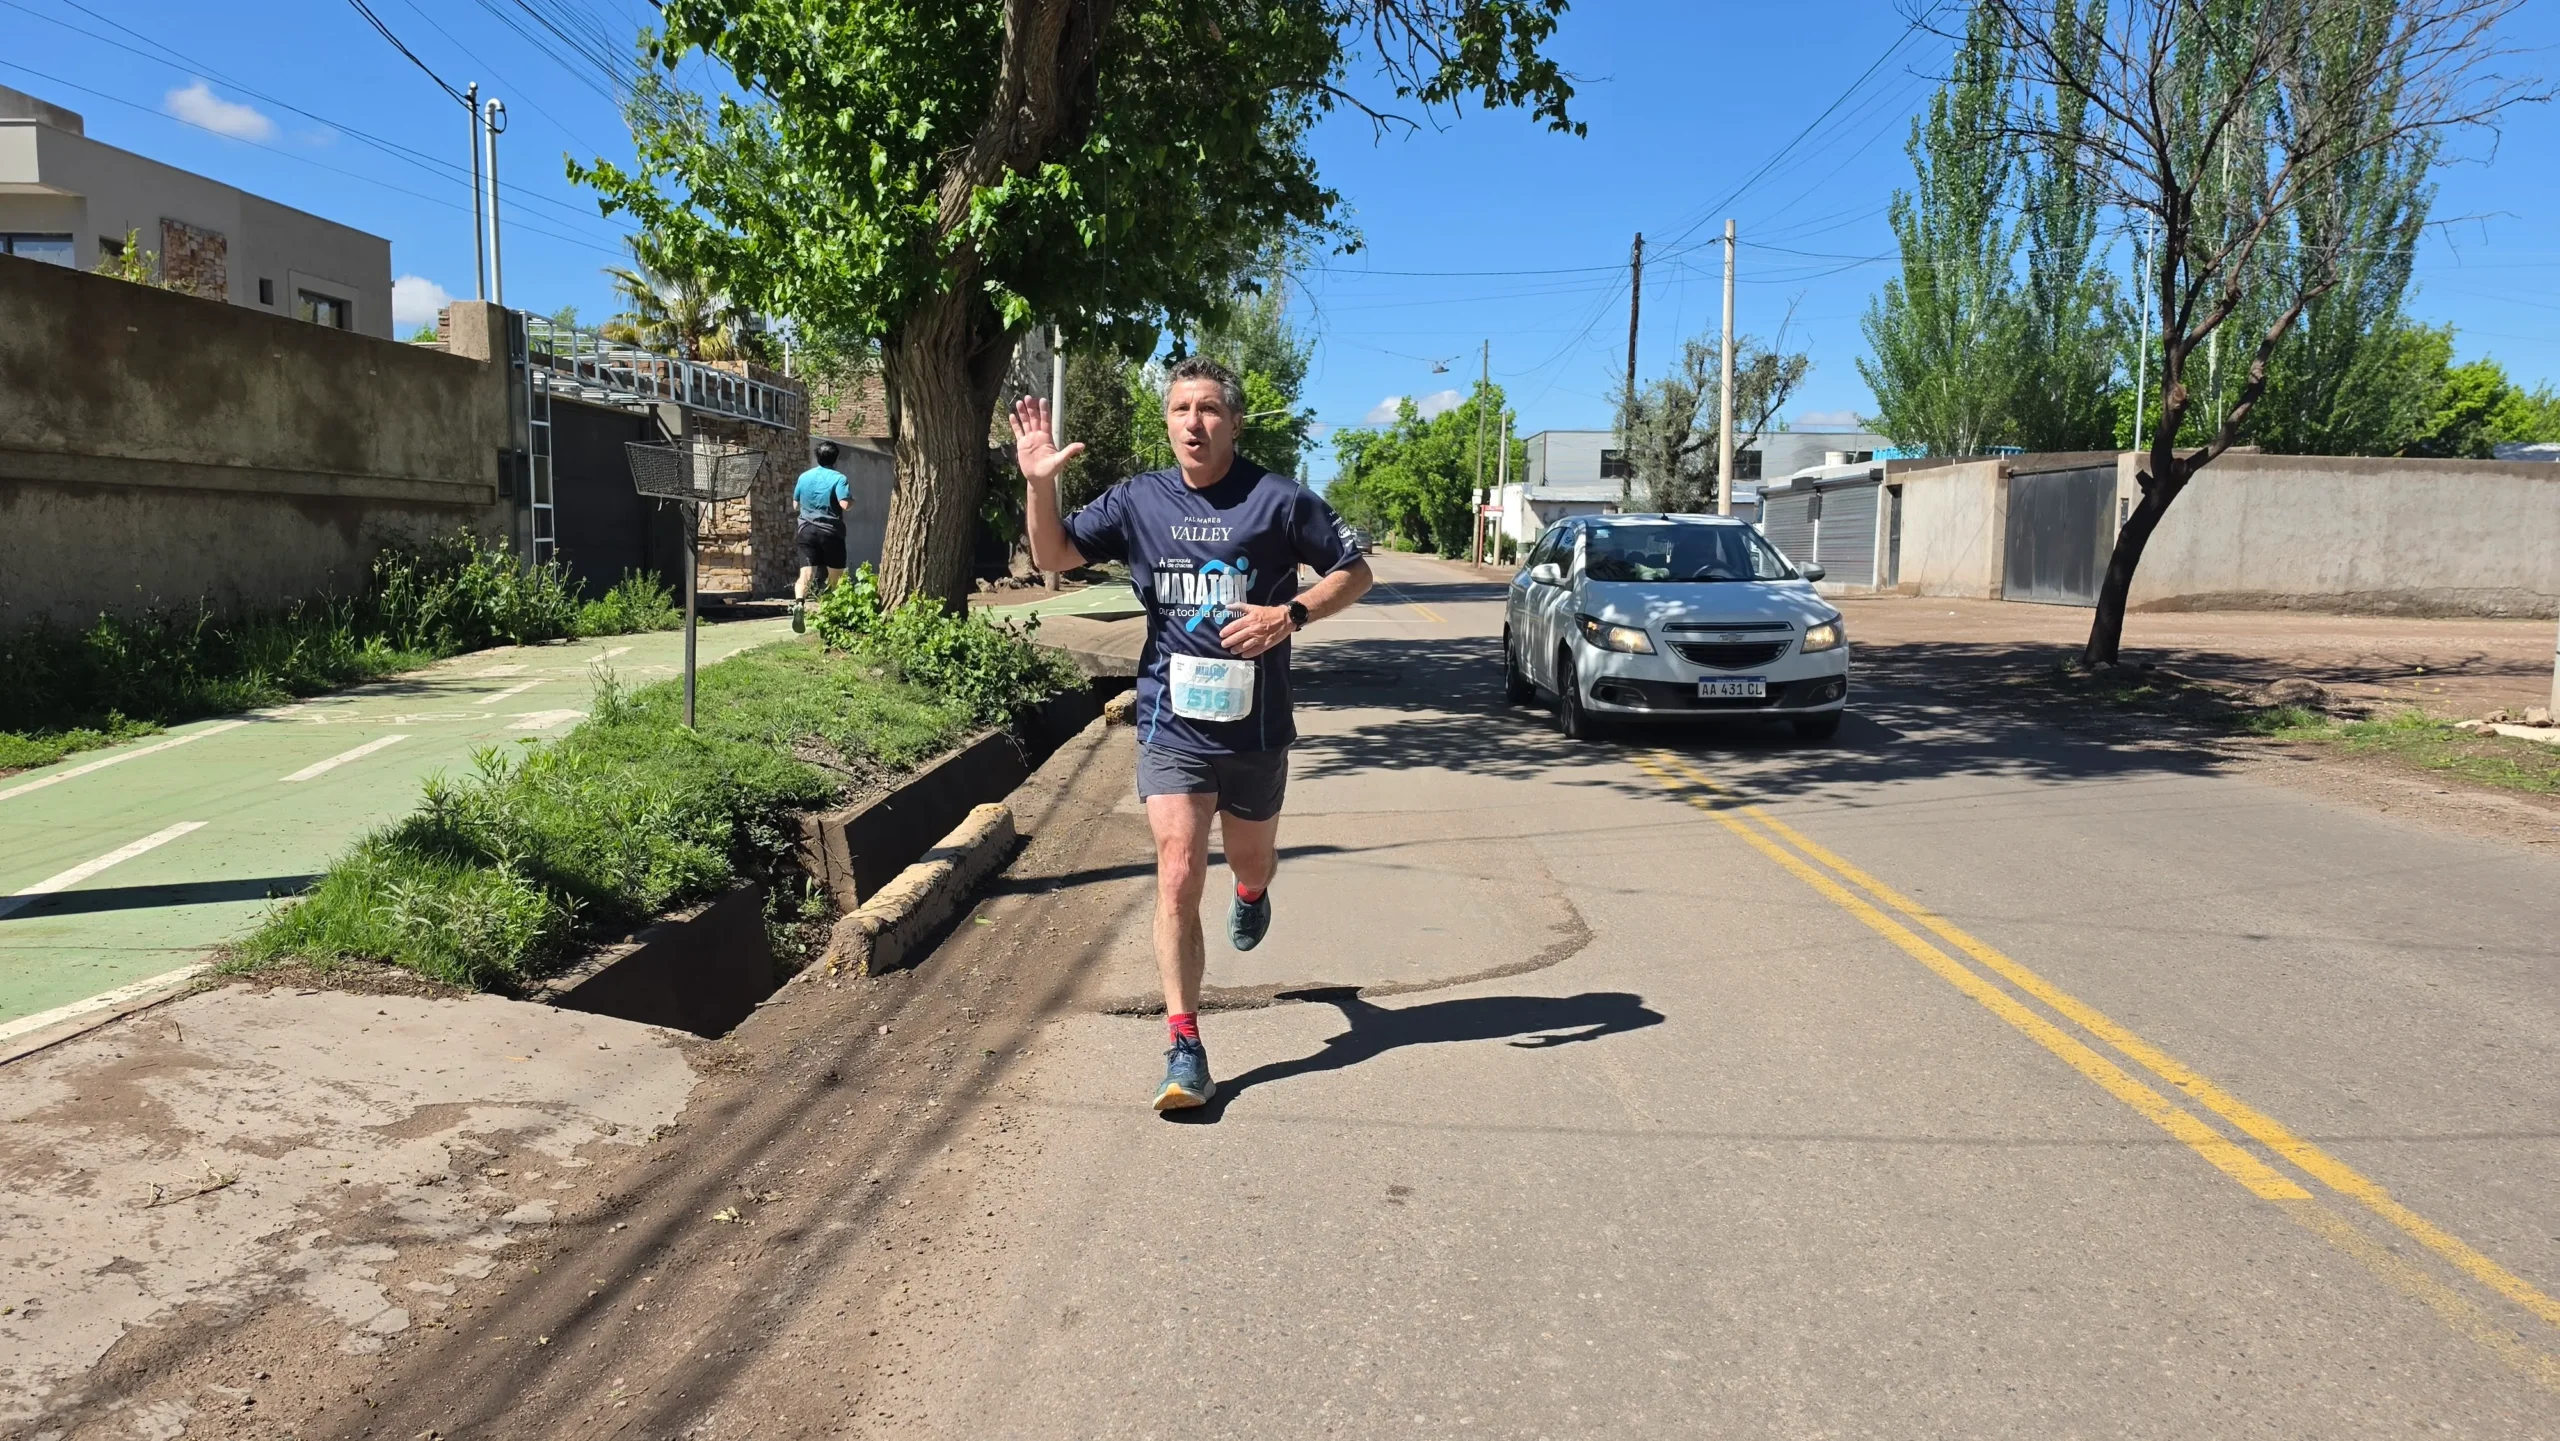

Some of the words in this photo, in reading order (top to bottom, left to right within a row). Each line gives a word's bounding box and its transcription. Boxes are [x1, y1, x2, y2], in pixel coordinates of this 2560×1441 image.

[1170, 525, 1233, 541] VALLEY
[1153, 566, 1248, 605] MARATÓN
[1177, 606, 1200, 617] toda
[1202, 607, 1211, 618] la
[1702, 683, 1716, 695] AA
[1721, 683, 1744, 695] 431
[1747, 683, 1763, 695] CL
[1187, 687, 1230, 710] 516
